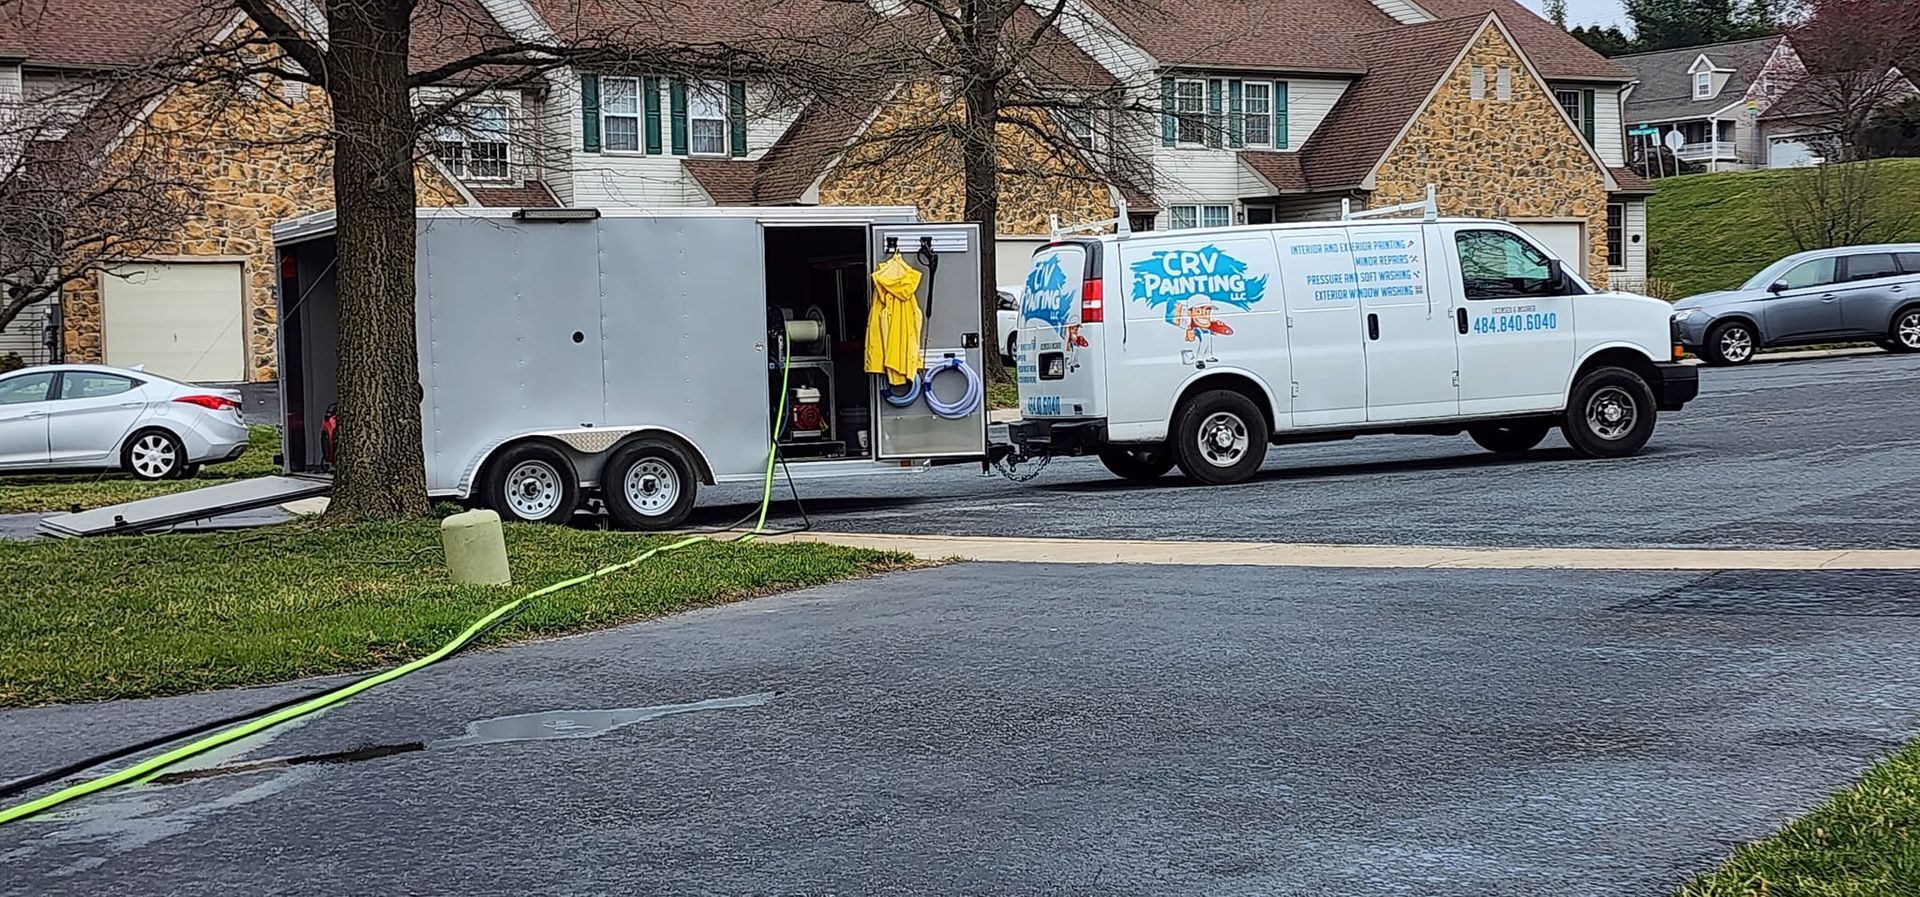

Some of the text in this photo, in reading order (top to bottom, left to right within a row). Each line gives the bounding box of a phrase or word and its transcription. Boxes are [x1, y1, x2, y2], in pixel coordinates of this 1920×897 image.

[1290, 239, 1406, 255] INTERIOR AND EXERIOR PAINTING
[1162, 252, 1218, 276] CRV
[1355, 254, 1409, 266] MINOR REPAIRS
[1144, 273, 1245, 298] PAINTING
[1307, 275, 1343, 286] PRESSURE
[1360, 271, 1377, 283] SOFT
[1378, 269, 1411, 281] WASHING
[1230, 292, 1247, 301] LLC
[1315, 290, 1348, 301] EXTERIOR
[1381, 286, 1413, 296] WASHING
[1474, 313, 1556, 334] 484.840.6040
